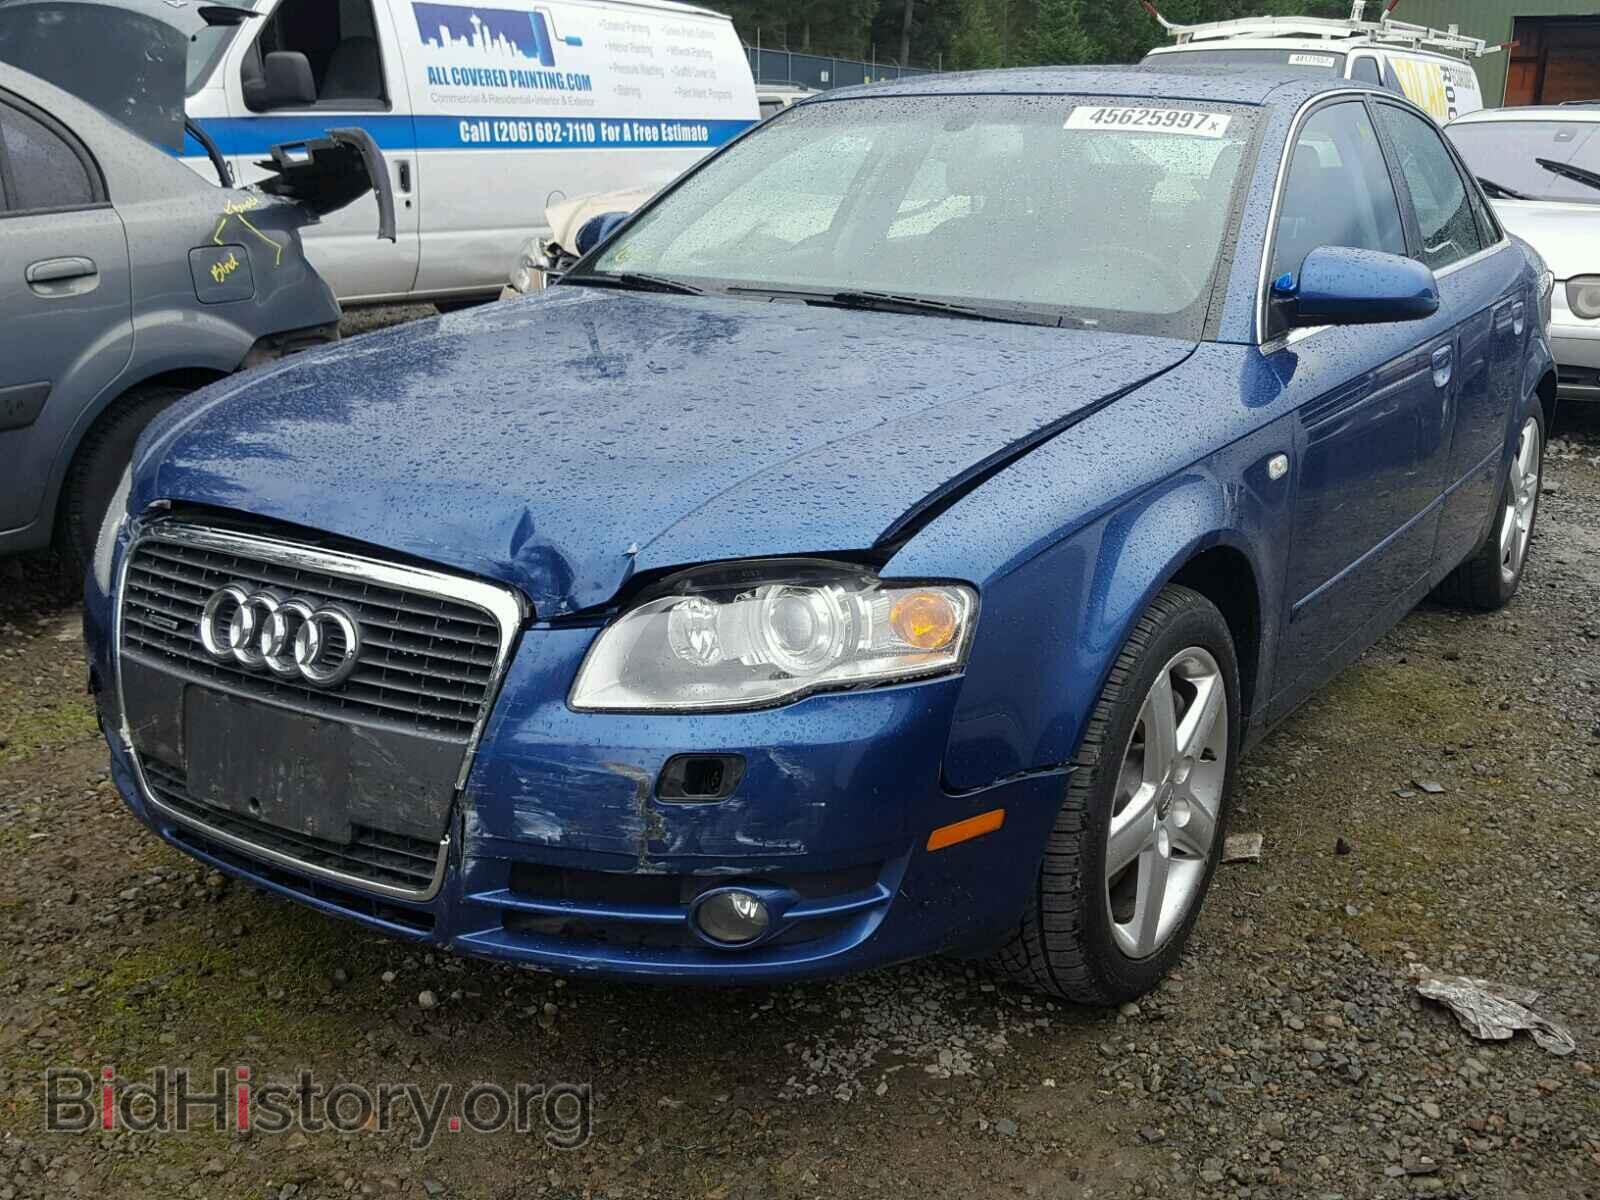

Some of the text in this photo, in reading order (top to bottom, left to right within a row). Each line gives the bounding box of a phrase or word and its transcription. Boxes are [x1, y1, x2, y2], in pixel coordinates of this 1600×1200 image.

[427, 66, 593, 91] ALL COVERED PAINTING.COM
[430, 92, 480, 104] Commercial
[1089, 108, 1209, 129] 45625997
[459, 121, 491, 143] Call
[601, 123, 621, 141] For
[623, 123, 632, 141] A
[633, 123, 659, 141] Free
[661, 123, 708, 142] Estimate
